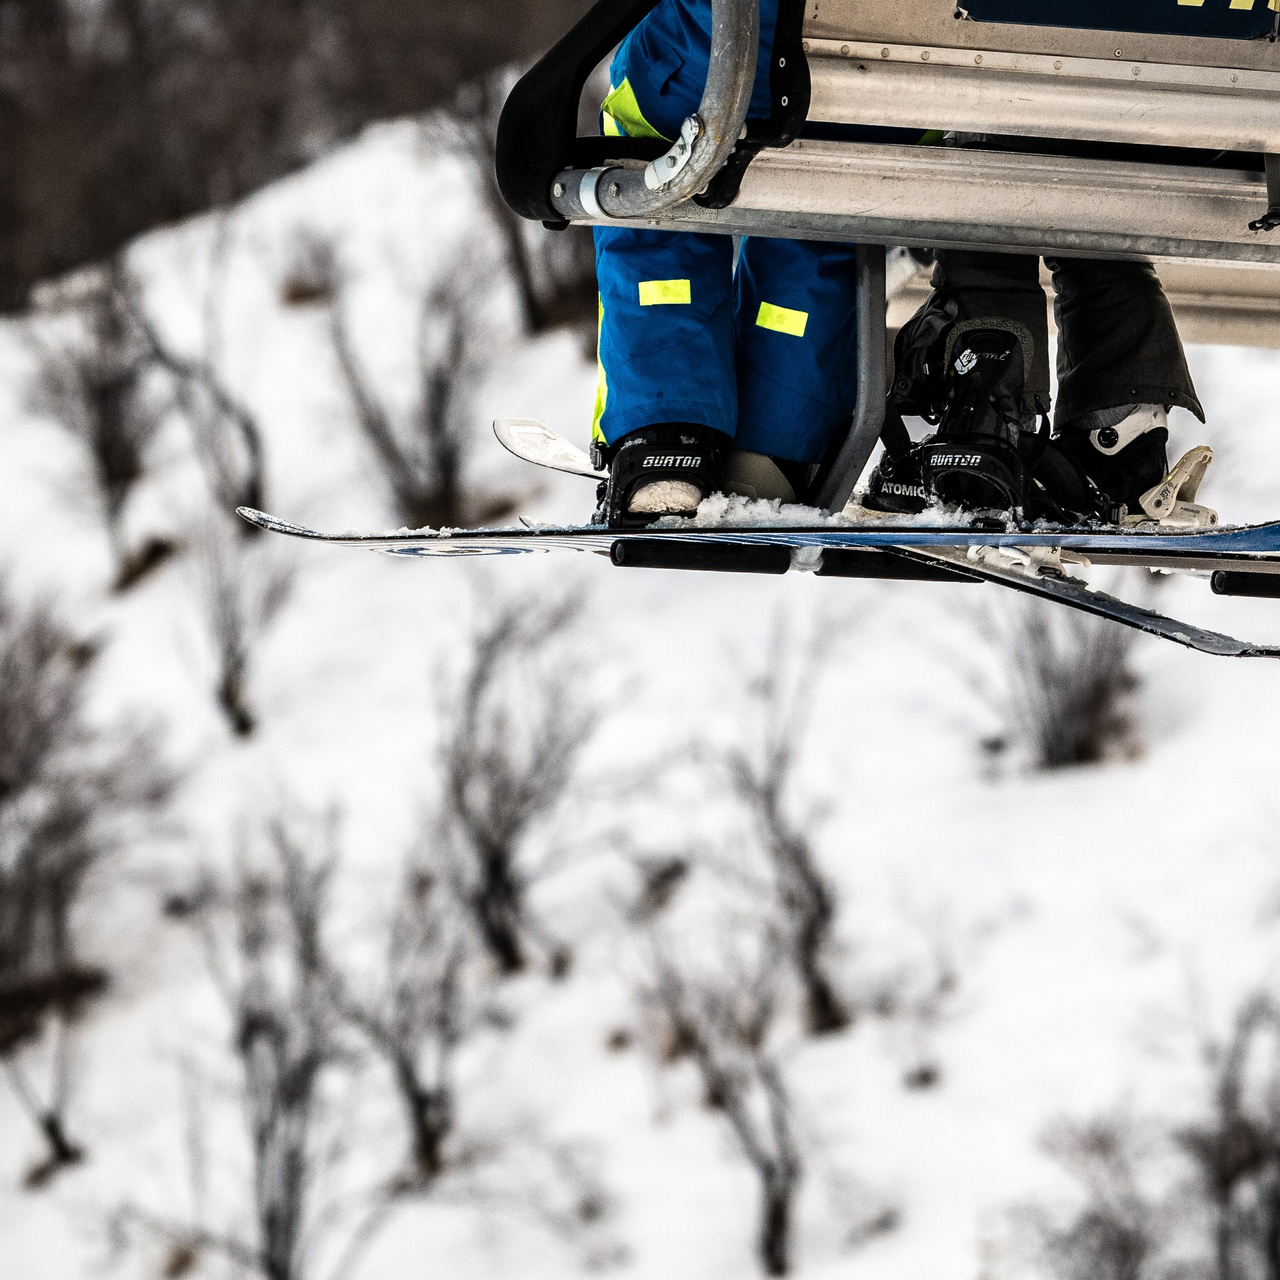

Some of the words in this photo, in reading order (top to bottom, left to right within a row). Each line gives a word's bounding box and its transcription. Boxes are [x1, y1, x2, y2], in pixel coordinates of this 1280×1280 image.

[642, 455, 702, 468] BURTON
[930, 455, 982, 466] BURTON
[881, 481, 926, 498] ATOMIC
[1160, 487, 1172, 501] JOY
[1180, 506, 1200, 515] HEAD
